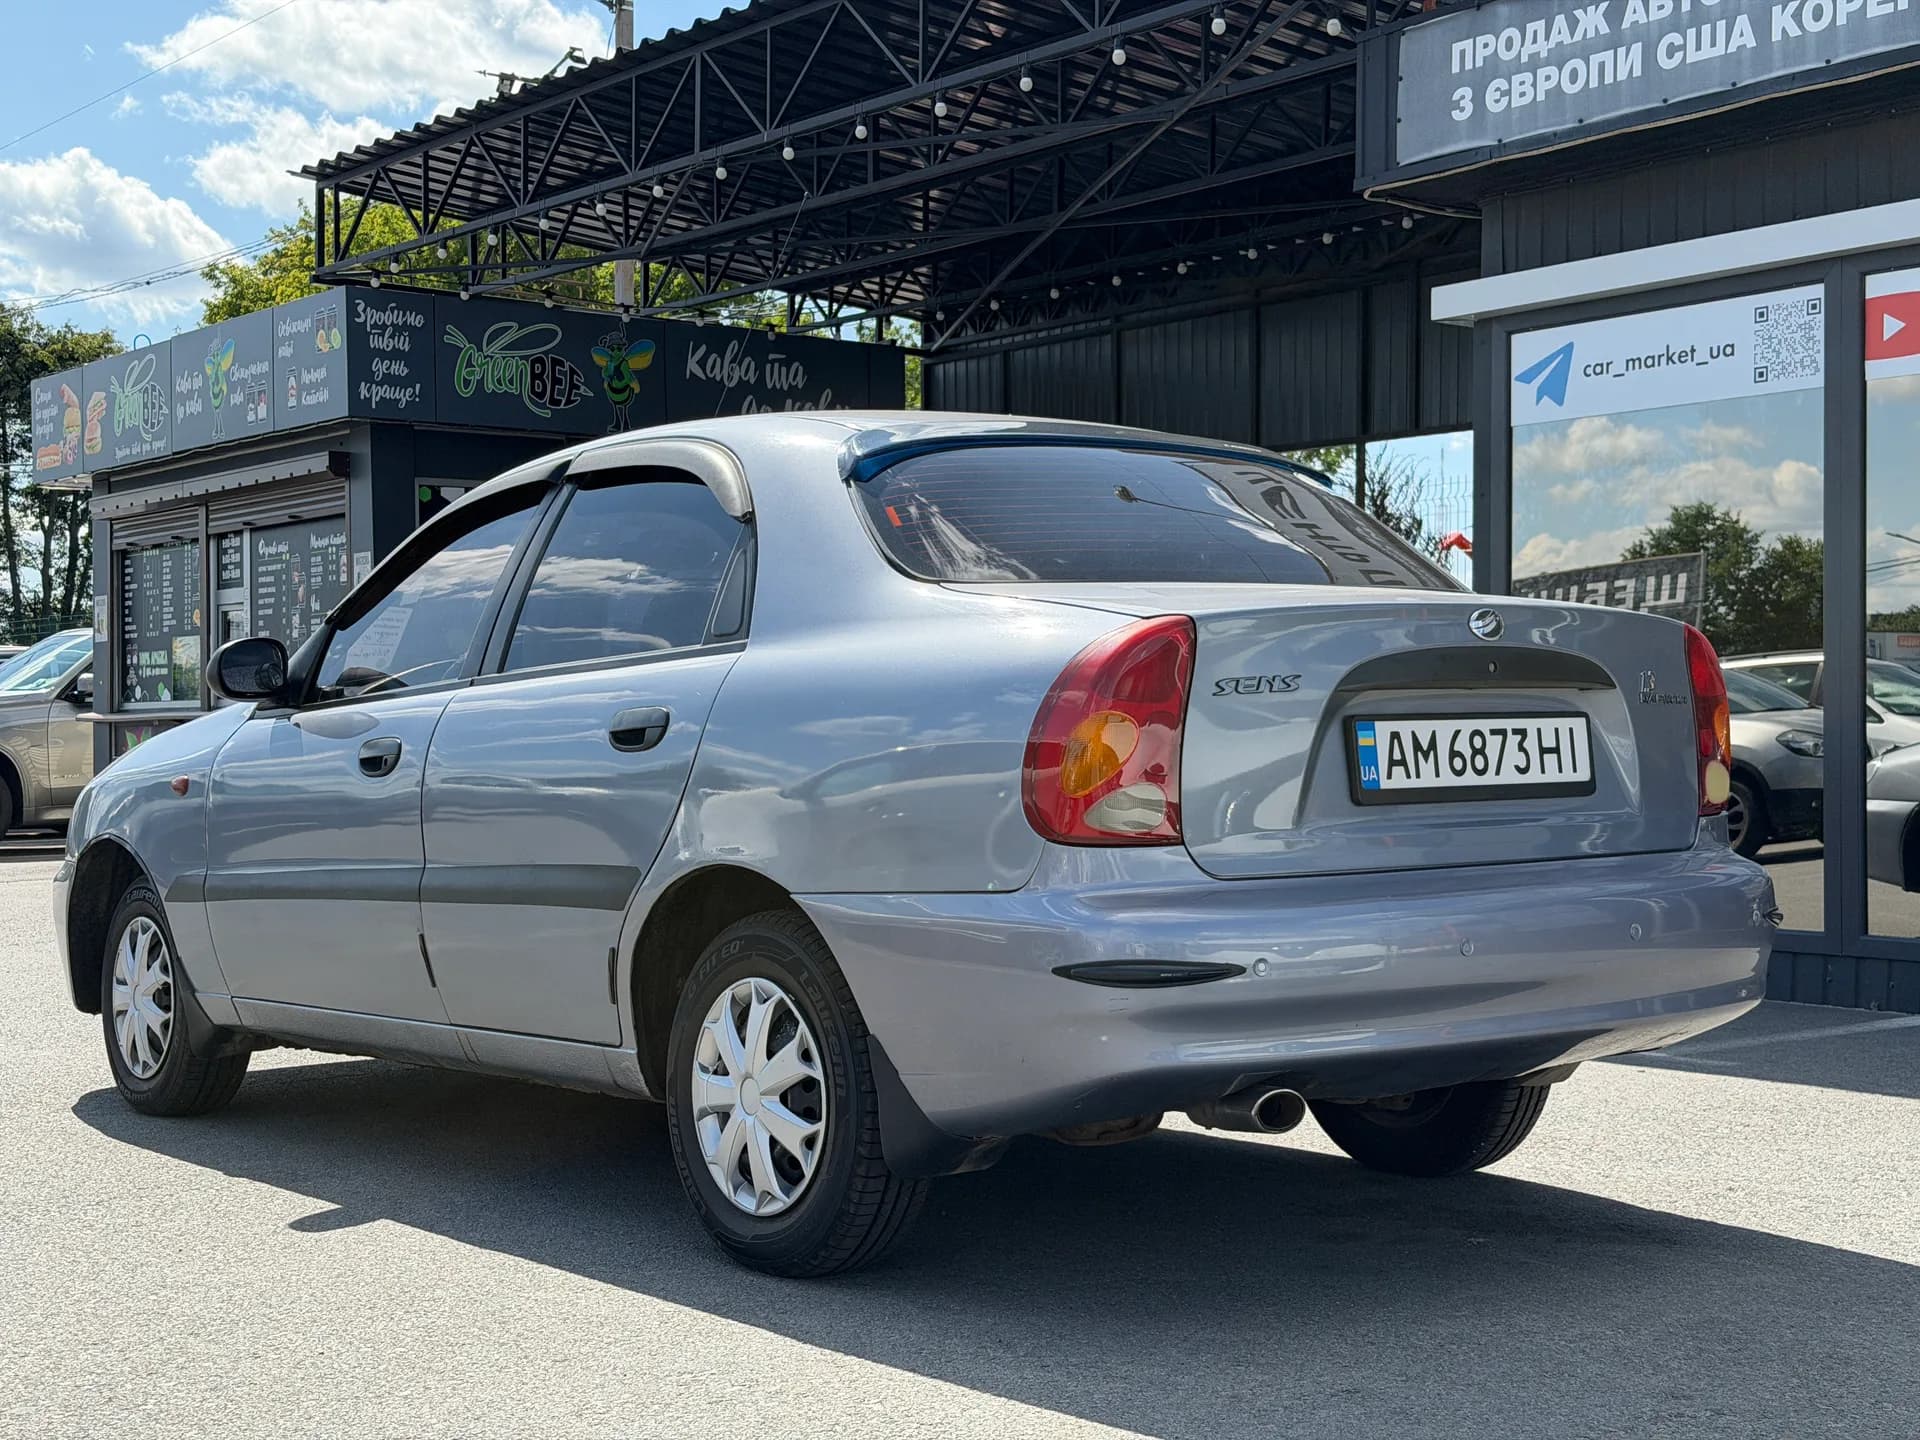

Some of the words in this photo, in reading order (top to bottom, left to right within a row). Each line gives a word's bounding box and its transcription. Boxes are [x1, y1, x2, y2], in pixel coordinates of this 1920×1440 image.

[1451, 1, 1610, 73] ПРОДАЖ
[1621, 0, 1720, 29] АВ
[1450, 86, 1473, 121] З
[1485, 41, 1642, 113] ЄВРОПИ
[1656, 14, 1757, 71] США
[1771, 0, 1909, 41] КОРЕ
[354, 300, 424, 332] Зробимо
[369, 326, 411, 352] твій
[371, 357, 409, 381] день
[686, 339, 759, 388] Кава
[765, 353, 808, 391] та
[1583, 343, 1735, 378] car_market_ua
[359, 381, 421, 409] краще!
[1212, 674, 1302, 696] SENS
[1361, 766, 1378, 782] UA
